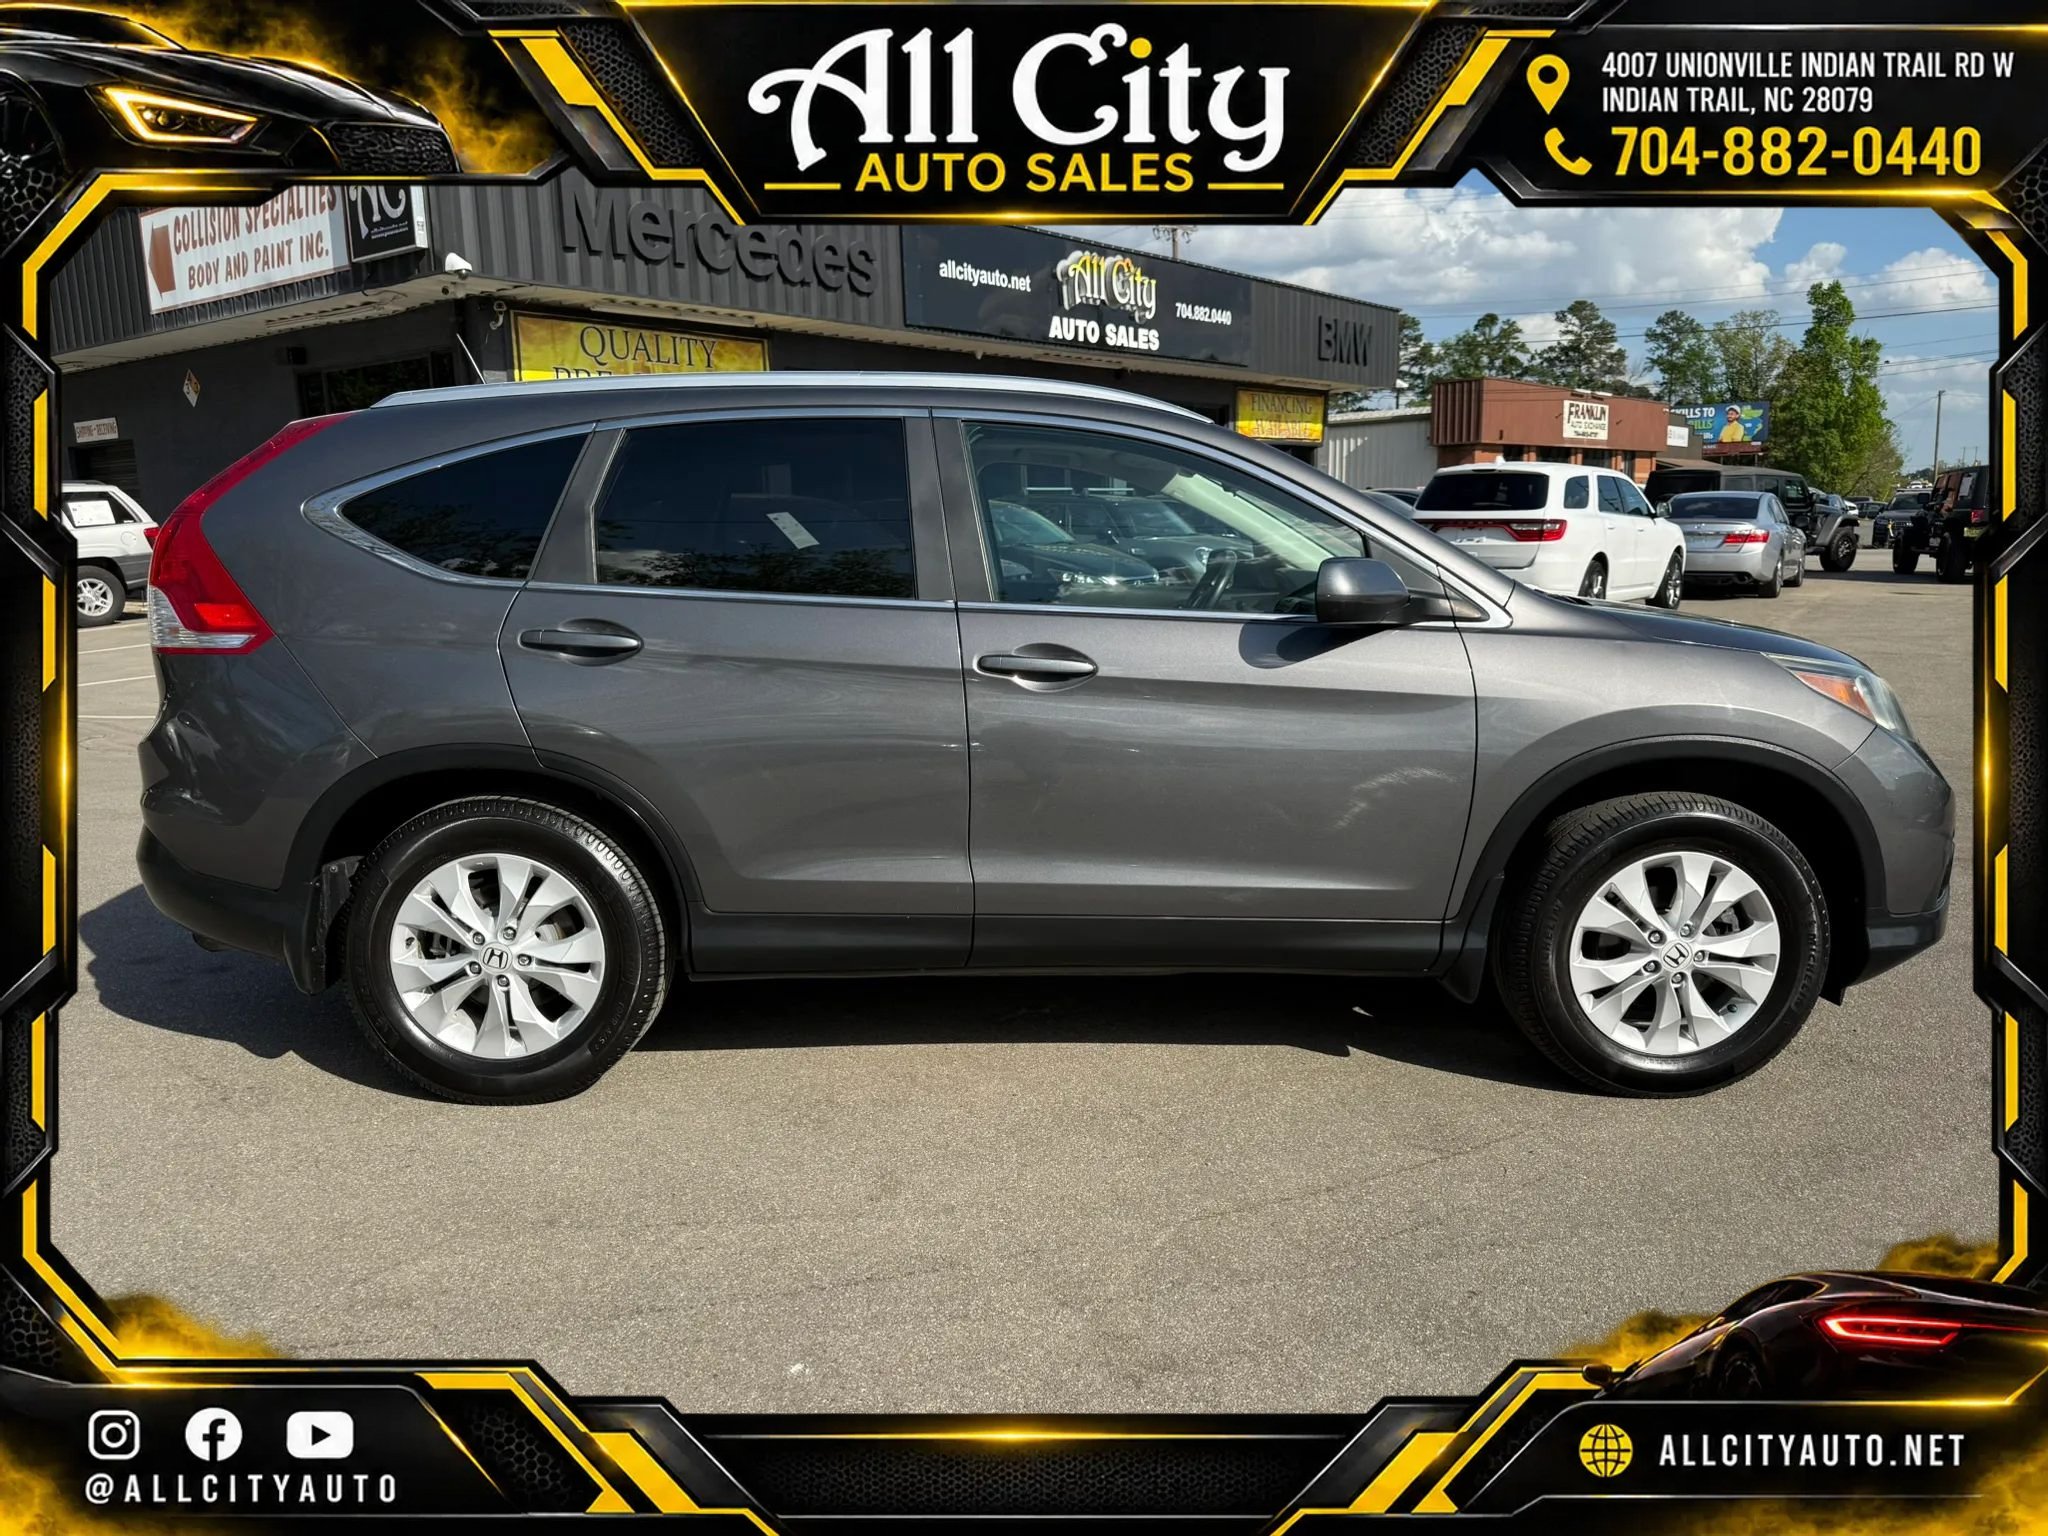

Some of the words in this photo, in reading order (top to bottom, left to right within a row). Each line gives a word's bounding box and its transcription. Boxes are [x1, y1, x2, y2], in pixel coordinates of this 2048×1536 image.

[174, 207, 240, 255] COLLISION
[559, 168, 878, 297] Mercedes
[188, 257, 220, 291] BODY
[225, 251, 249, 283] AND
[254, 238, 293, 273] PAINT
[300, 230, 329, 263] INC.
[939, 259, 1031, 292] allcityauto.net
[1057, 250, 1105, 310] All
[1108, 257, 1157, 324] City
[1049, 316, 1100, 344] AUTO
[1105, 323, 1160, 351] SALES
[1175, 302, 1232, 326] 704.882.0440
[580, 326, 717, 369] QUALITY
[1317, 315, 1374, 367] BMW
[1251, 393, 1313, 415] FINANCING
[1568, 402, 1607, 424] FRANKLIN
[1702, 407, 1715, 418] TO
